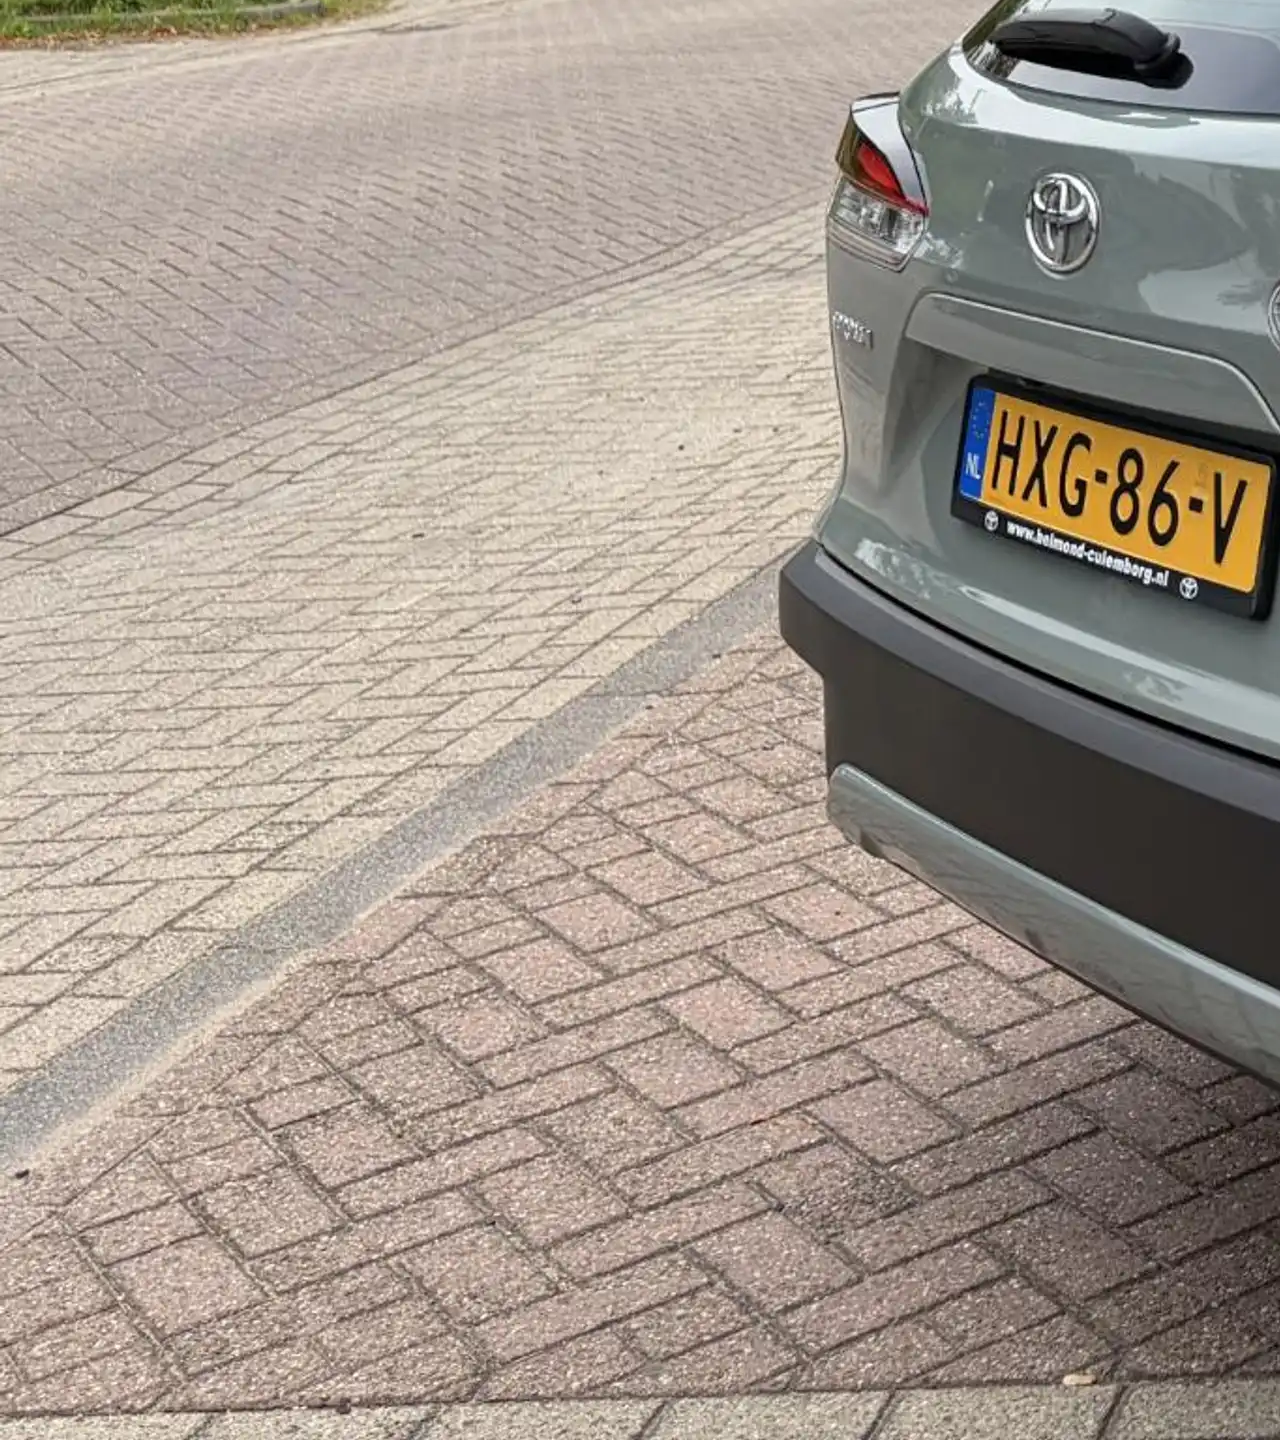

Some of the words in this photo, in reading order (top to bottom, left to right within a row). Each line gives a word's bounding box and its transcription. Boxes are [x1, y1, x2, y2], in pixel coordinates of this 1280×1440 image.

[965, 452, 982, 480] NL
[991, 410, 1248, 565] HXG-86-V
[1006, 520, 1170, 587] www.helmond-culemborg.nl
